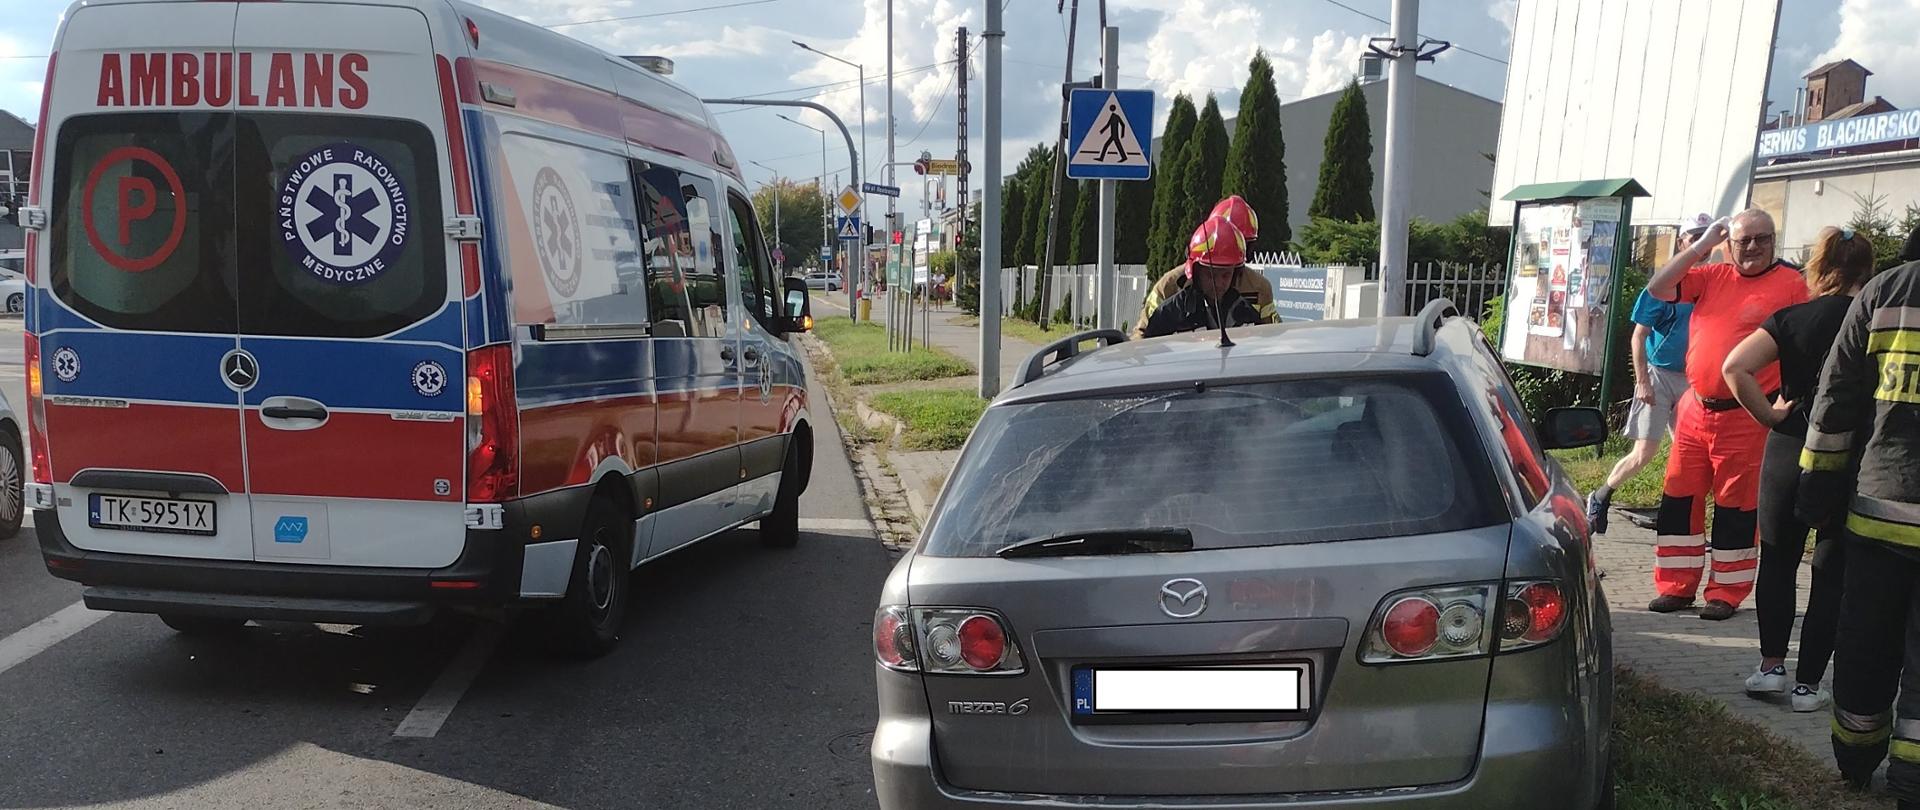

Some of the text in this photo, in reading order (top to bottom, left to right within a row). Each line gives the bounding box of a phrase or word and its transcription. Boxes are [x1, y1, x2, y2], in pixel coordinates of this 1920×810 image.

[96, 52, 369, 110] AMBULANS
[1816, 109, 1920, 148] BLACHARSKO
[117, 176, 157, 246] P
[279, 149, 333, 241] PAŃSTWOWE
[353, 150, 407, 245] RATOWNICTWO
[302, 255, 385, 282] MEDYCZNE
[105, 498, 207, 527] TK 5951X
[1077, 698, 1091, 710] PL
